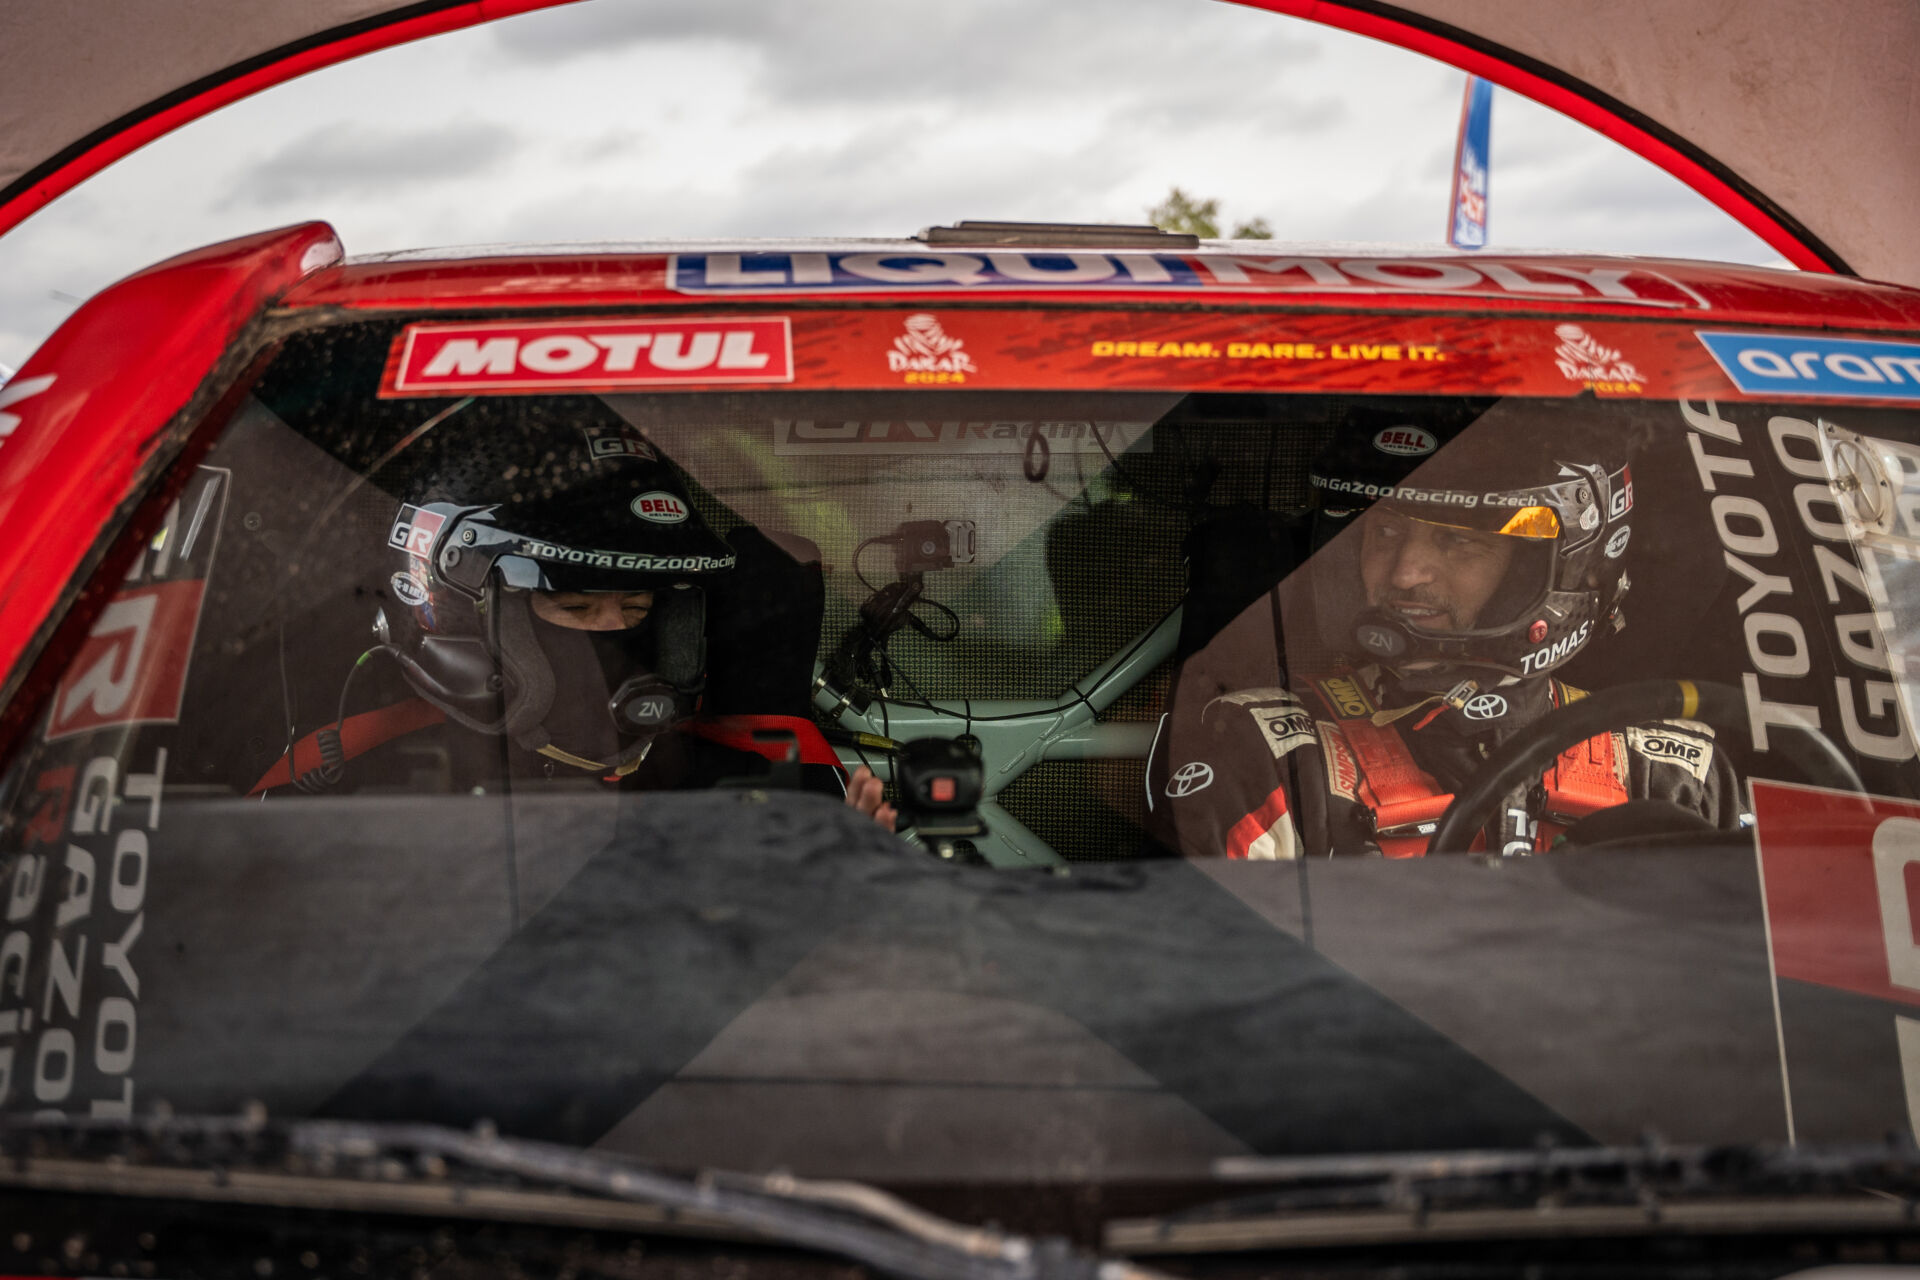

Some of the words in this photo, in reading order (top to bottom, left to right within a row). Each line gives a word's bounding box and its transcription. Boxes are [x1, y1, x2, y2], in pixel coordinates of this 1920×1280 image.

[704, 253, 1173, 286] LIQUI
[1200, 256, 1641, 299] MOLY
[422, 331, 770, 377] MOTUL
[887, 350, 978, 373] DAKAR
[1091, 341, 1221, 358] DREAM.
[1227, 343, 1325, 359] DARE.
[1331, 344, 1401, 360] LIVE
[1408, 345, 1446, 361] IT.
[1555, 359, 1648, 384] DAKAR
[593, 437, 653, 457] GR
[1381, 431, 1427, 449] BELL
[640, 499, 683, 514] BELL
[1328, 479, 1396, 497] GAZOO
[1396, 487, 1479, 508] Racing
[1482, 492, 1538, 507] Czech
[1611, 481, 1633, 517] GR
[391, 521, 435, 553] GR
[529, 541, 613, 567] TOYOTA
[616, 555, 698, 570] GAZOO
[1679, 398, 1822, 753] TOYOTA
[1520, 619, 1590, 676] TOMAS
[637, 701, 664, 719] ZN
[1326, 678, 1367, 716] OMP
[1644, 738, 1702, 760] OMP
[33, 757, 118, 1121] GAZO
[91, 747, 167, 1120] TOYOT
